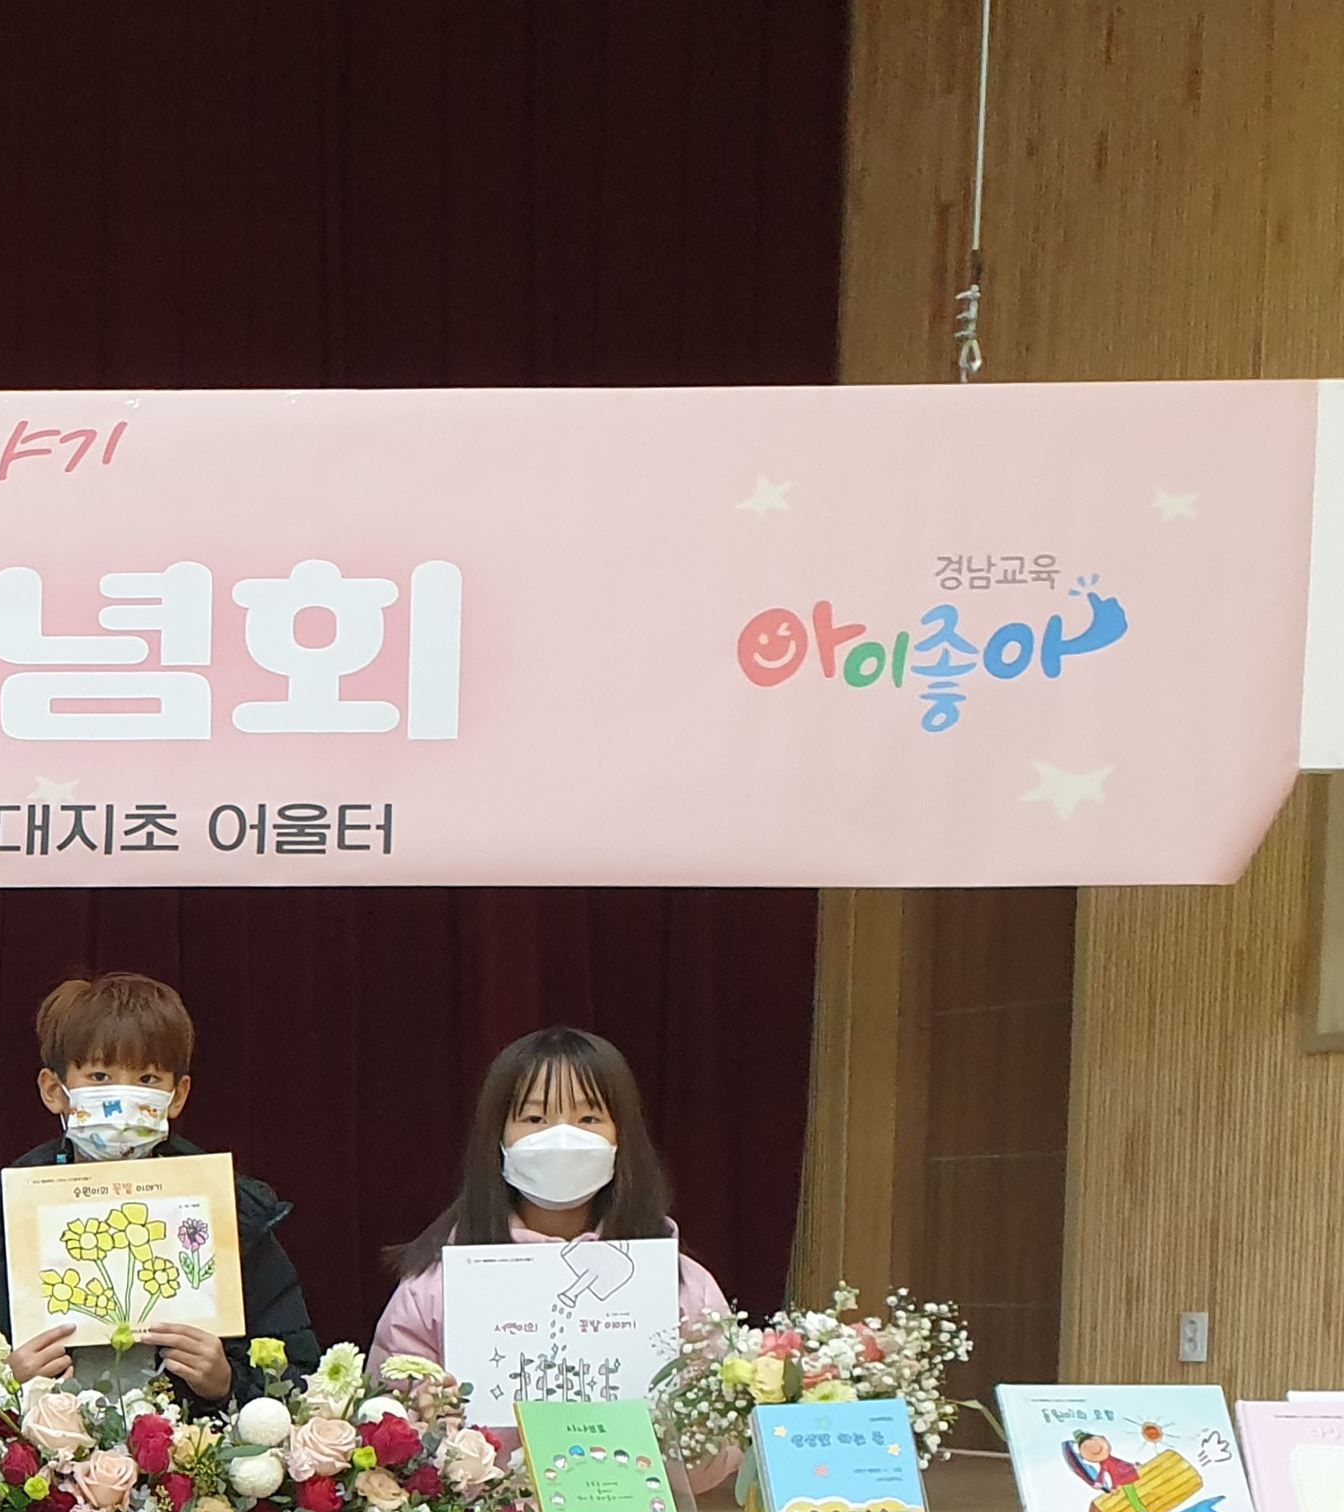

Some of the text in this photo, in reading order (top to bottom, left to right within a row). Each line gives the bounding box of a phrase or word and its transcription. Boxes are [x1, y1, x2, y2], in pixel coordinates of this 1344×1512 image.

[933, 553, 1061, 592] 경남교육
[736, 589, 1129, 735] 아이좋아
[206, 801, 396, 857] 어울터
